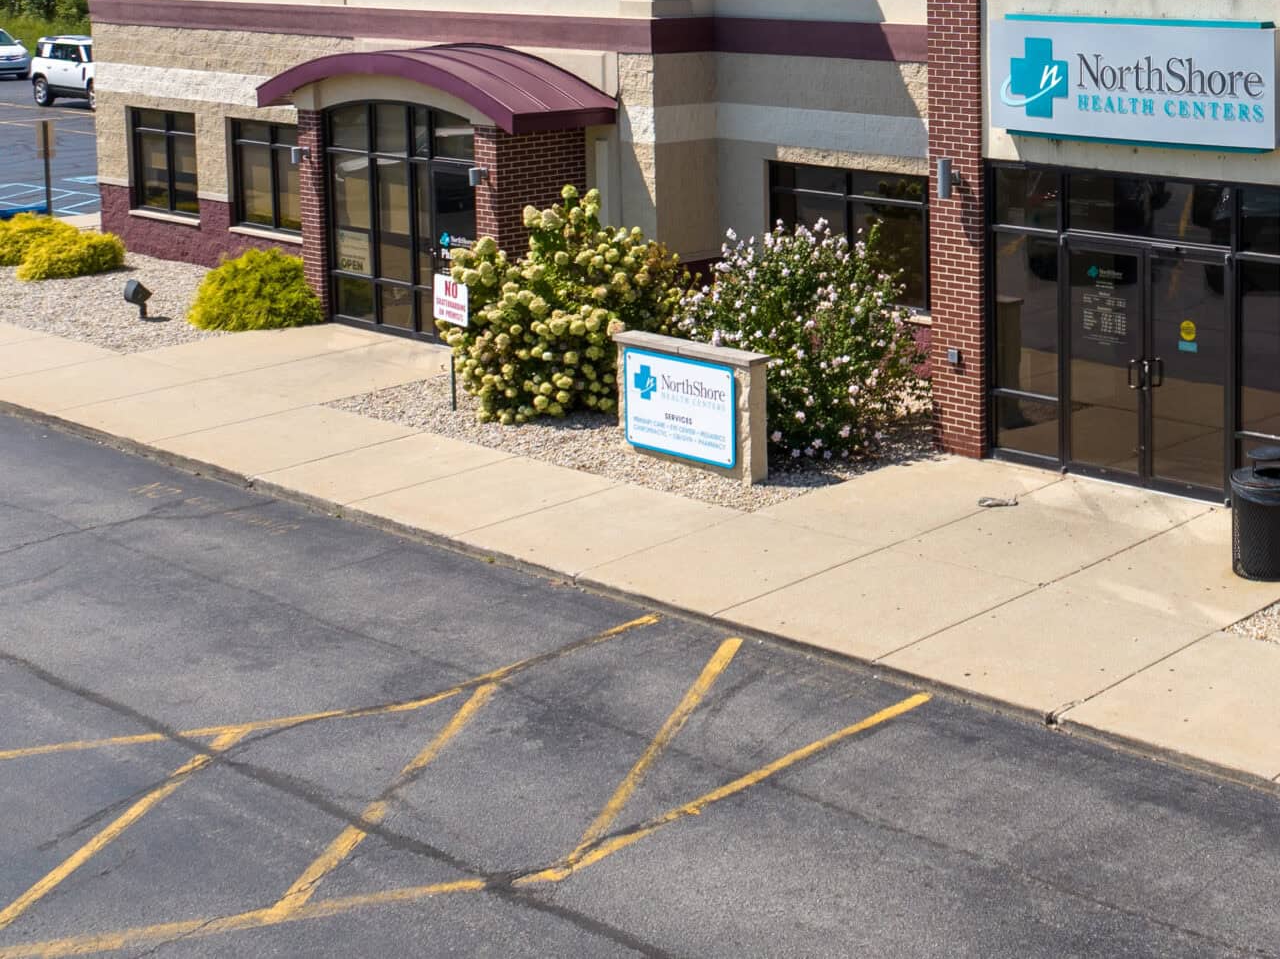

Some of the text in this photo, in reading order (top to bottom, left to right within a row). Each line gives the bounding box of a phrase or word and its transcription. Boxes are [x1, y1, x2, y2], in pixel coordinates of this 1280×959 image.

[1076, 52, 1265, 98] NorthShore
[1077, 95, 1266, 123] HEALTH CENTERS
[341, 257, 364, 271] OPEN
[444, 280, 458, 299] NO
[661, 374, 726, 403] NorthShore
[661, 392, 726, 412] HEALTH CENTERS
[664, 412, 693, 425] SERVICES
